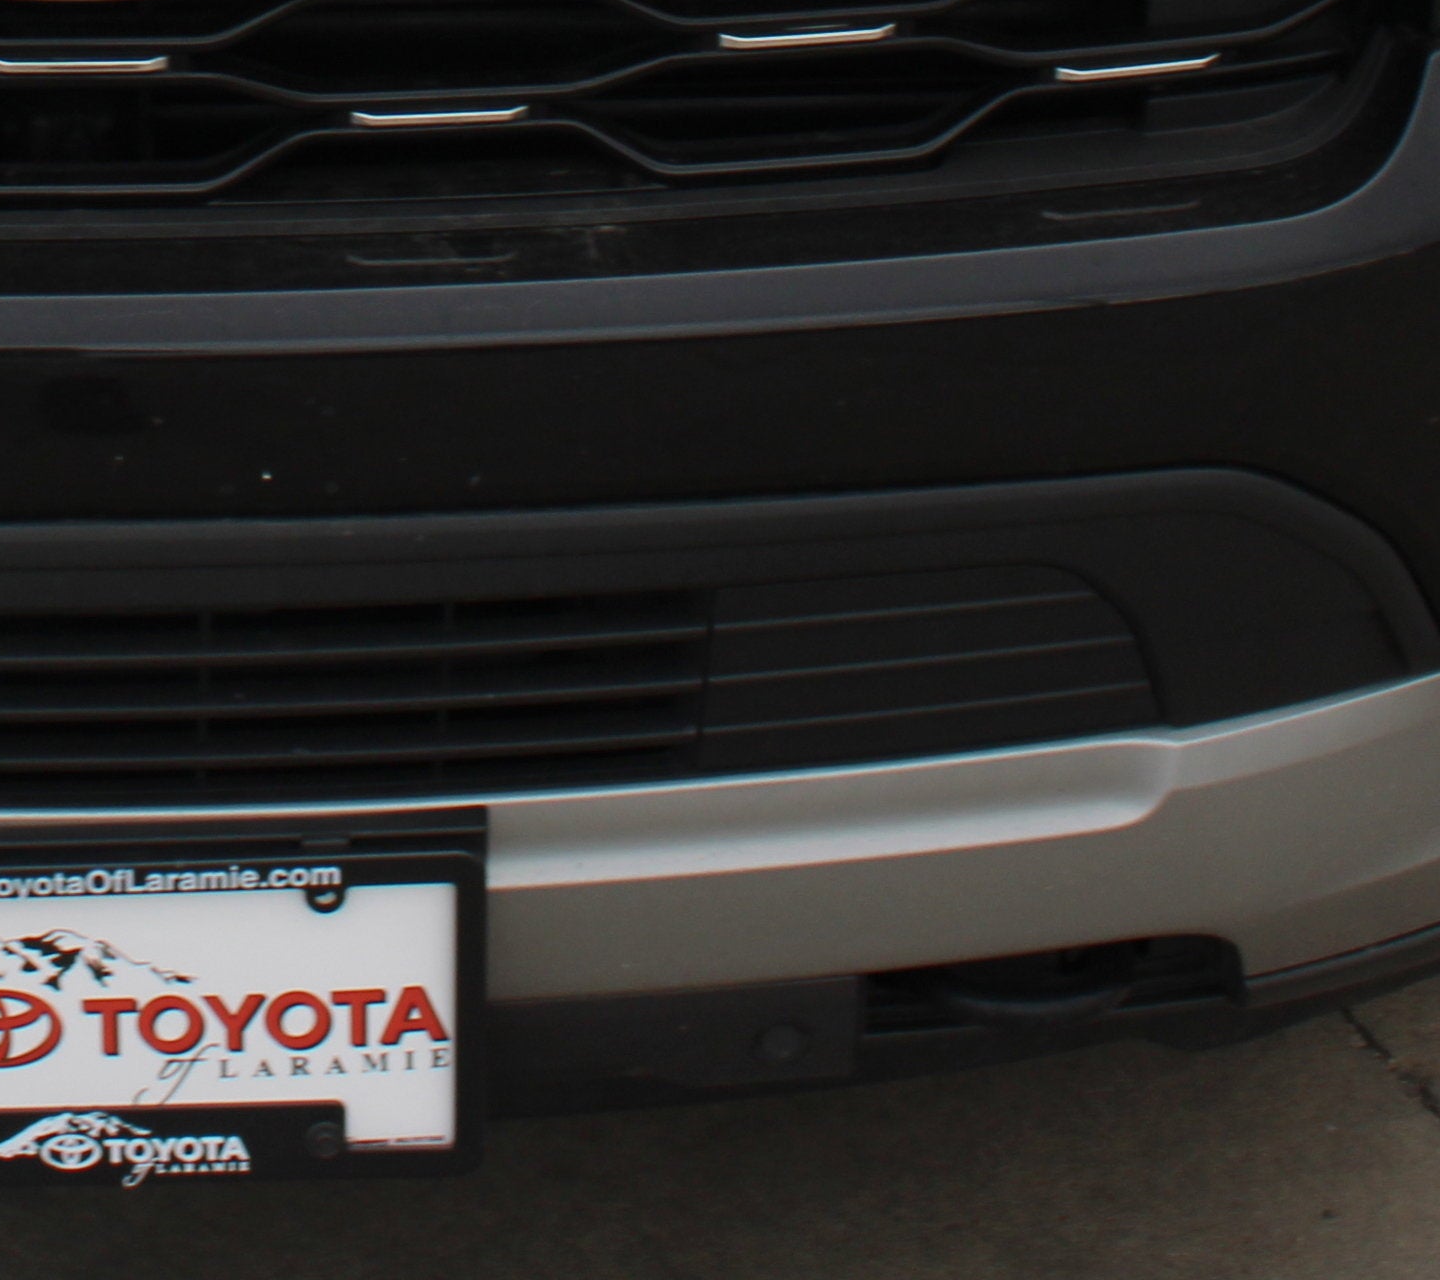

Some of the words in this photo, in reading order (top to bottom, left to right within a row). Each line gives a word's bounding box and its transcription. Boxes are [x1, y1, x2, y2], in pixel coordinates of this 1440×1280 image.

[81, 985, 451, 1056] TOYOTA
[132, 1043, 219, 1105] of
[219, 1048, 452, 1079] LARAMIE
[103, 1136, 251, 1164] TOYOTA
